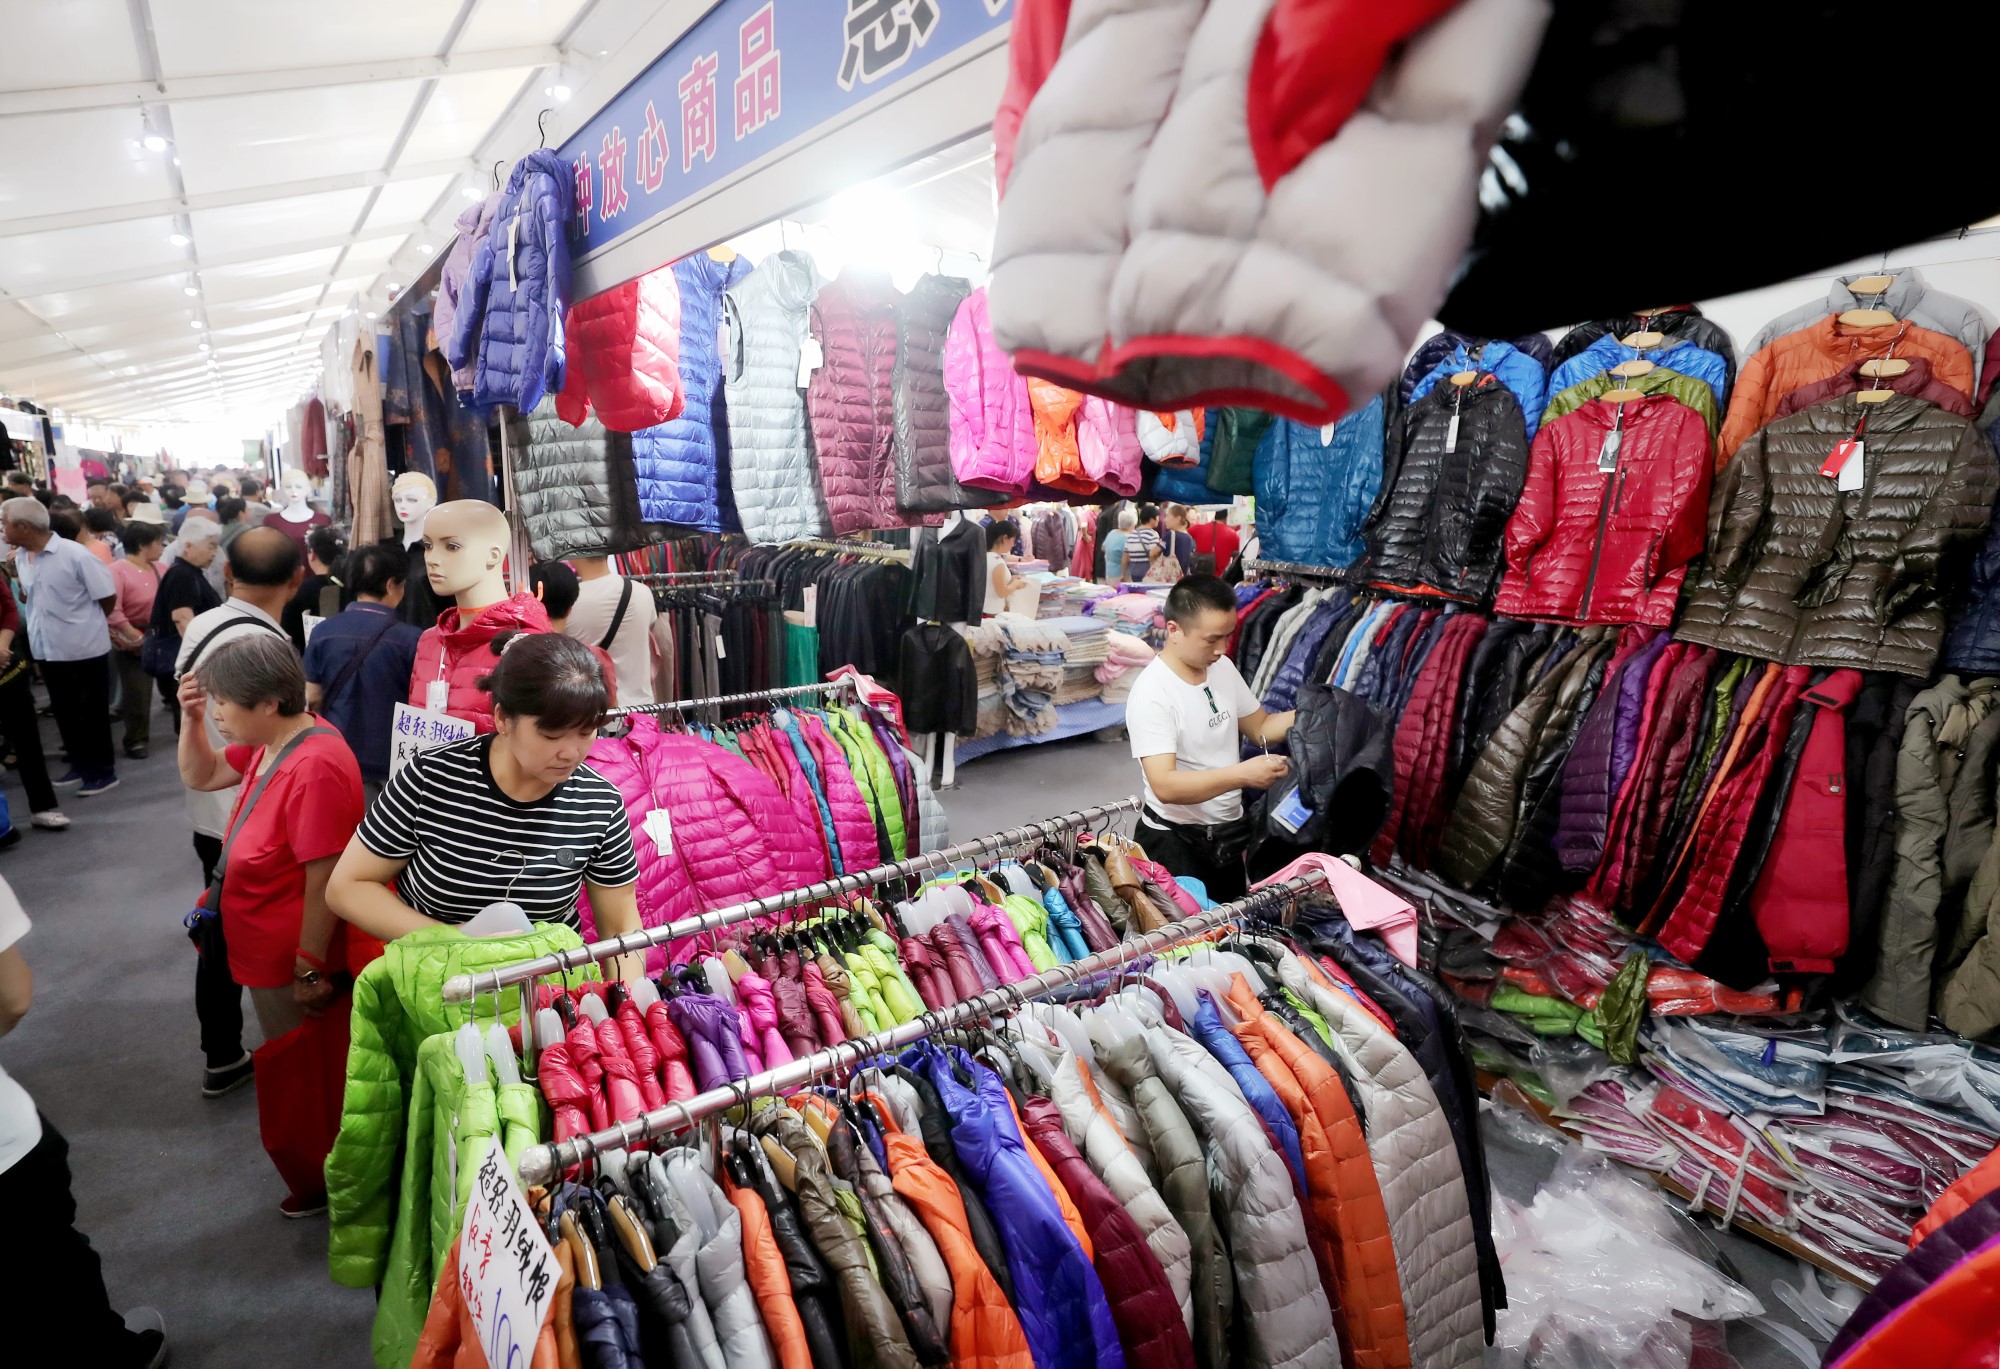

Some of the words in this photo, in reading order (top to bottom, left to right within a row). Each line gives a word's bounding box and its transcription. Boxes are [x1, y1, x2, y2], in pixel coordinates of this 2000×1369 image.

[1208, 711, 1231, 727] GUCCI
[478, 1148, 549, 1327] 超轻羽绒服
